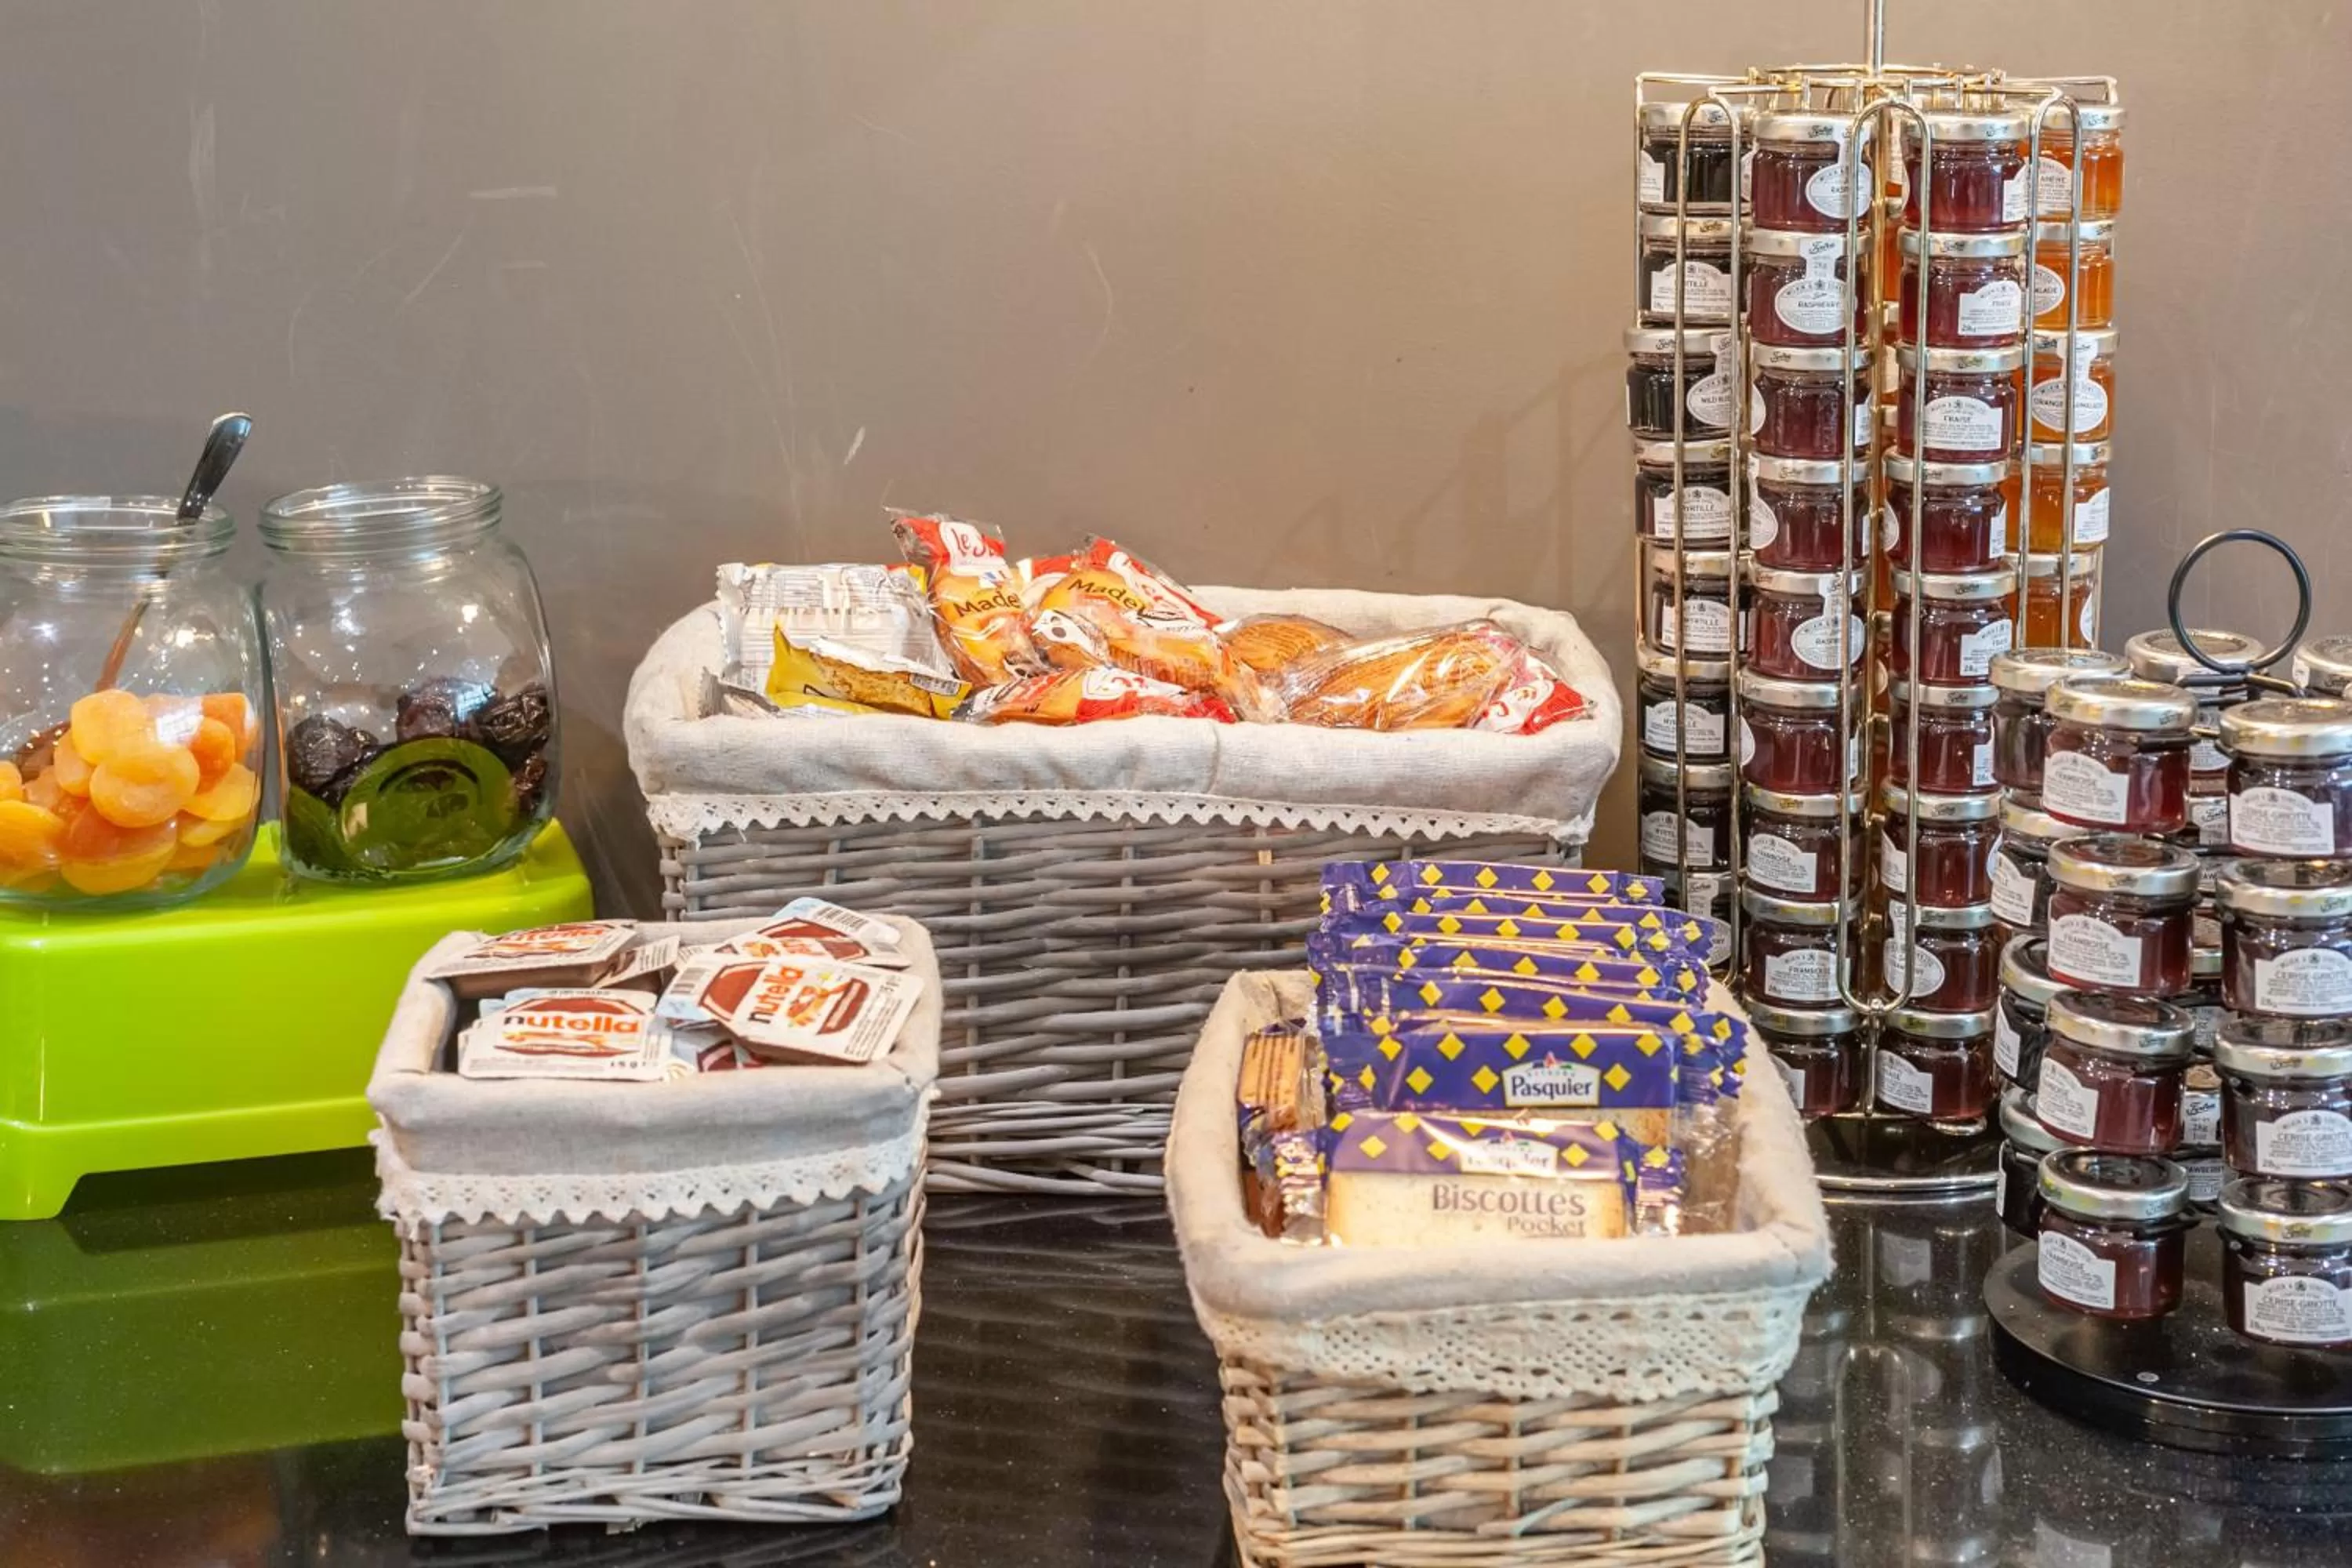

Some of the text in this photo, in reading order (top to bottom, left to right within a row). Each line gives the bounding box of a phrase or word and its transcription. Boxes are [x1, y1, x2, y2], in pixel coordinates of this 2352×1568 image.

[748, 966, 805, 1025] nutella
[503, 1014, 641, 1033] nutella
[1511, 1075, 1593, 1100] Pasquier
[1432, 1184, 1586, 1216] Biscottes
[1506, 1217, 1587, 1237] Pocket
